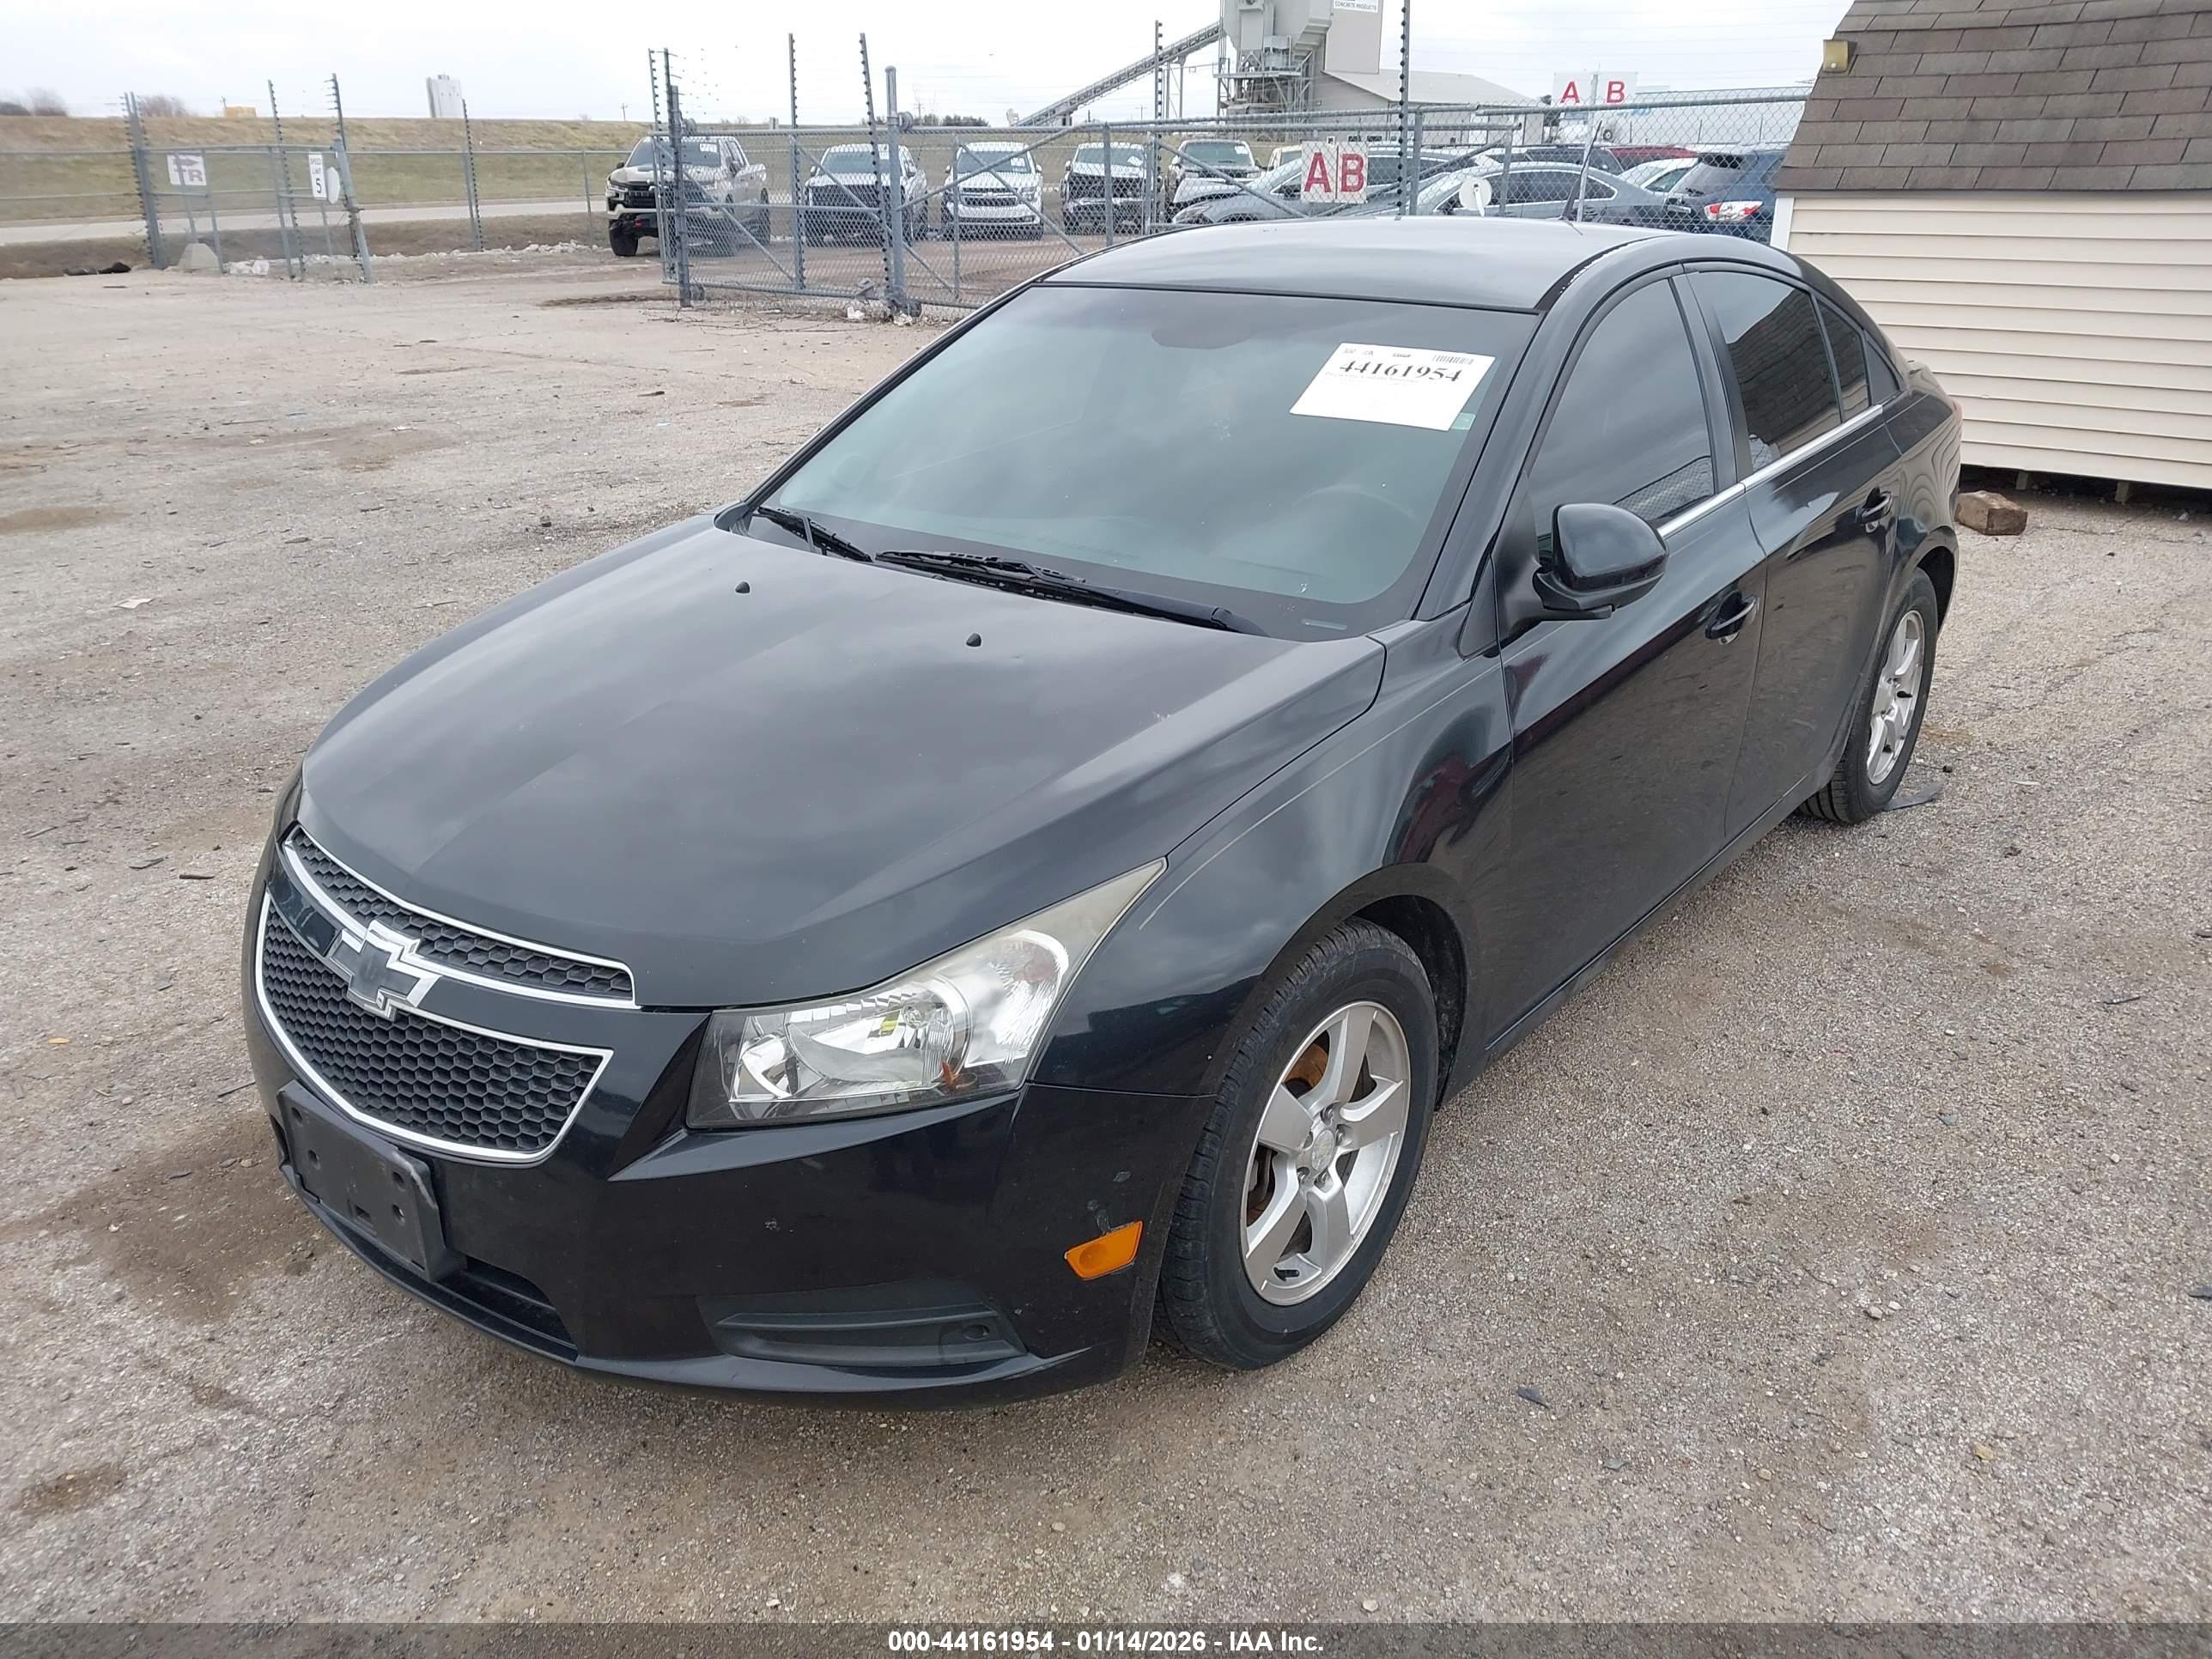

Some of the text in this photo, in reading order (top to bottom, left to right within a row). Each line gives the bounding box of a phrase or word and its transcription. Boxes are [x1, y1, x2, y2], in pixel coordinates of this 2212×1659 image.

[1560, 81, 1626, 104] A B
[1304, 152, 1364, 193] A B
[315, 178, 322, 194] 5
[1340, 360, 1462, 382] 44161954
